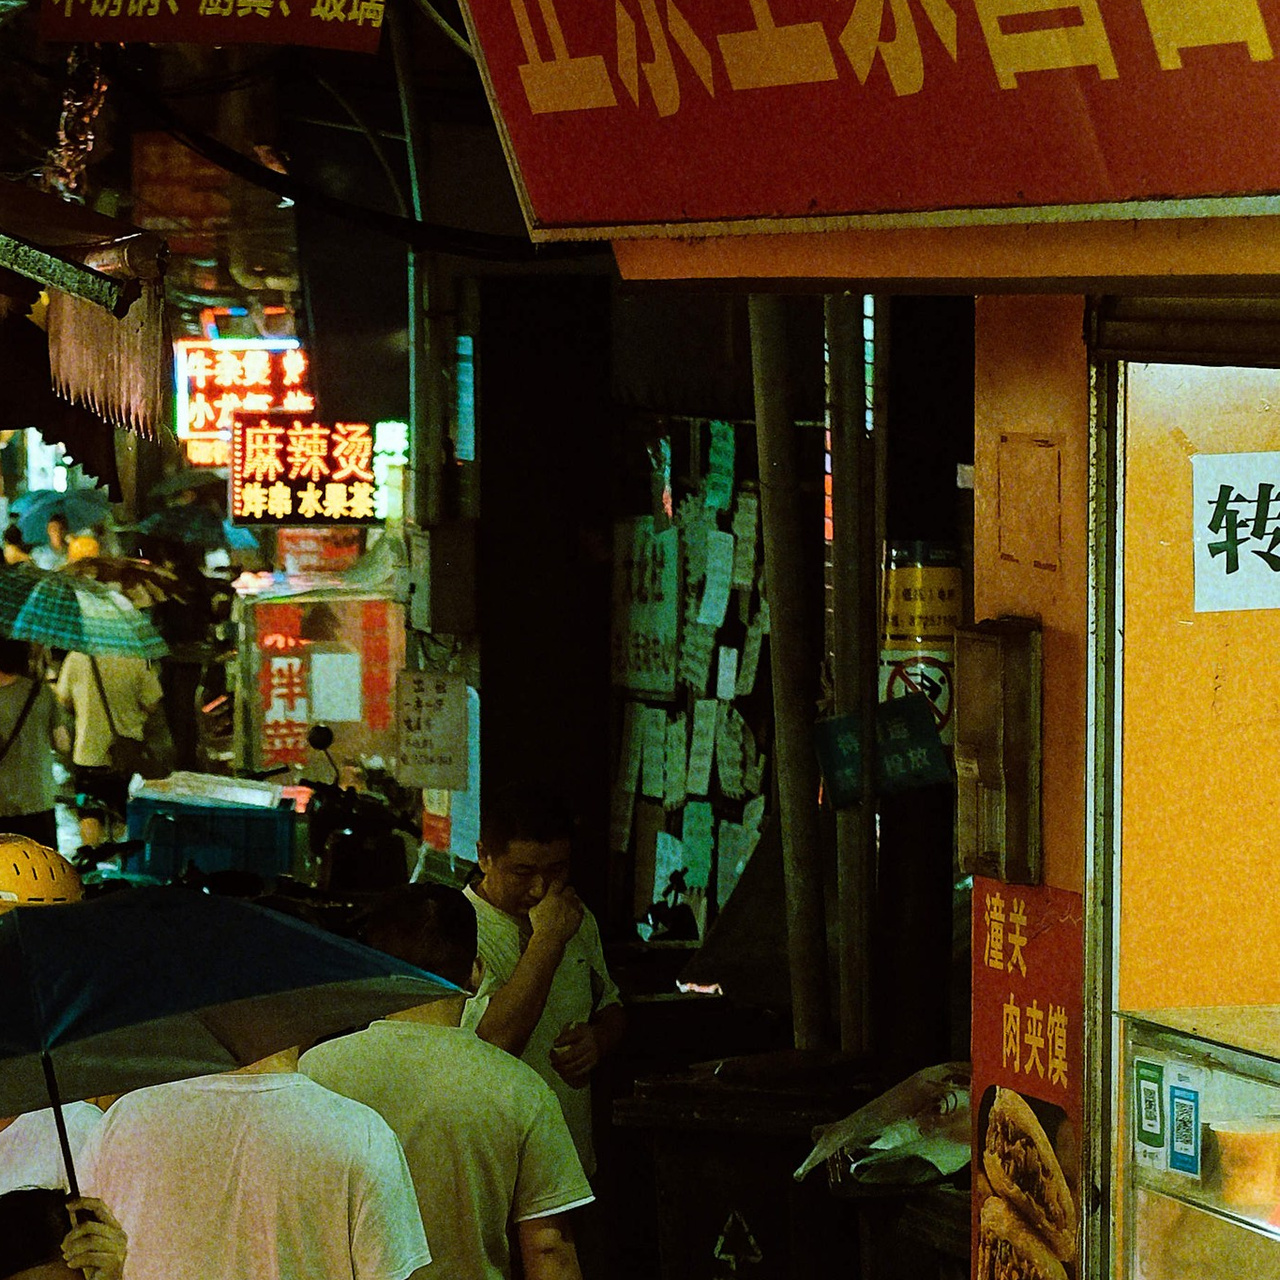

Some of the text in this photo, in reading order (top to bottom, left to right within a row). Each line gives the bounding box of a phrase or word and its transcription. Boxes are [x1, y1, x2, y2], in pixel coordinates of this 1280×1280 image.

[241, 420, 375, 482] 麻辣烫
[240, 480, 376, 519] 炸串 水果茶
[983, 891, 1028, 978] 潼关
[1002, 992, 1069, 1089] 肉夹馍
